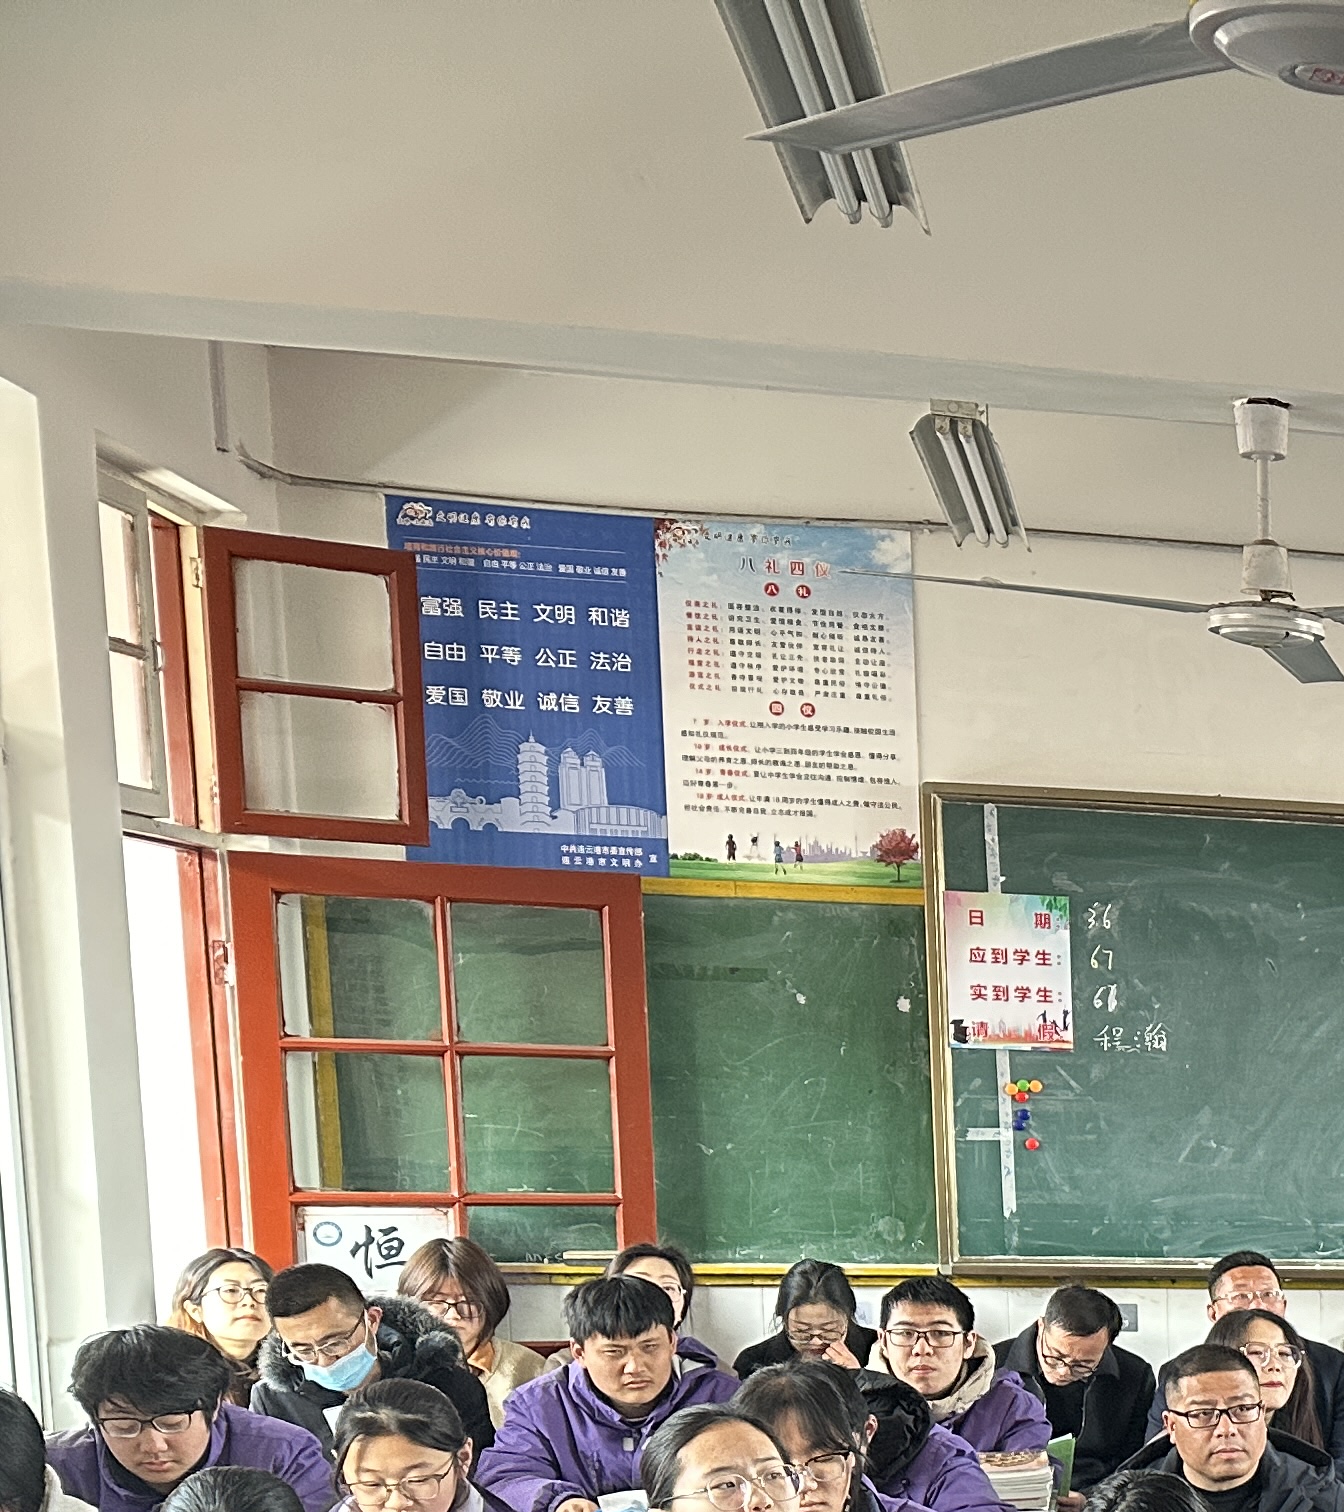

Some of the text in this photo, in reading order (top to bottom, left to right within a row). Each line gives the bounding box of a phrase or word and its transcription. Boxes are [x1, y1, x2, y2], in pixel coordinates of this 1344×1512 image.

[740, 556, 831, 578] 八礼四仪
[420, 596, 630, 628] 富强 民主 文明 和谐
[424, 642, 632, 672] 自由 平等 公正 法治
[426, 686, 634, 716] 爱国 敬业 诚信 友善
[969, 947, 1062, 967] 应到学生：
[1090, 944, 1113, 970] 67
[970, 984, 1064, 1003] 实到学生：
[349, 1224, 408, 1279] 恒
